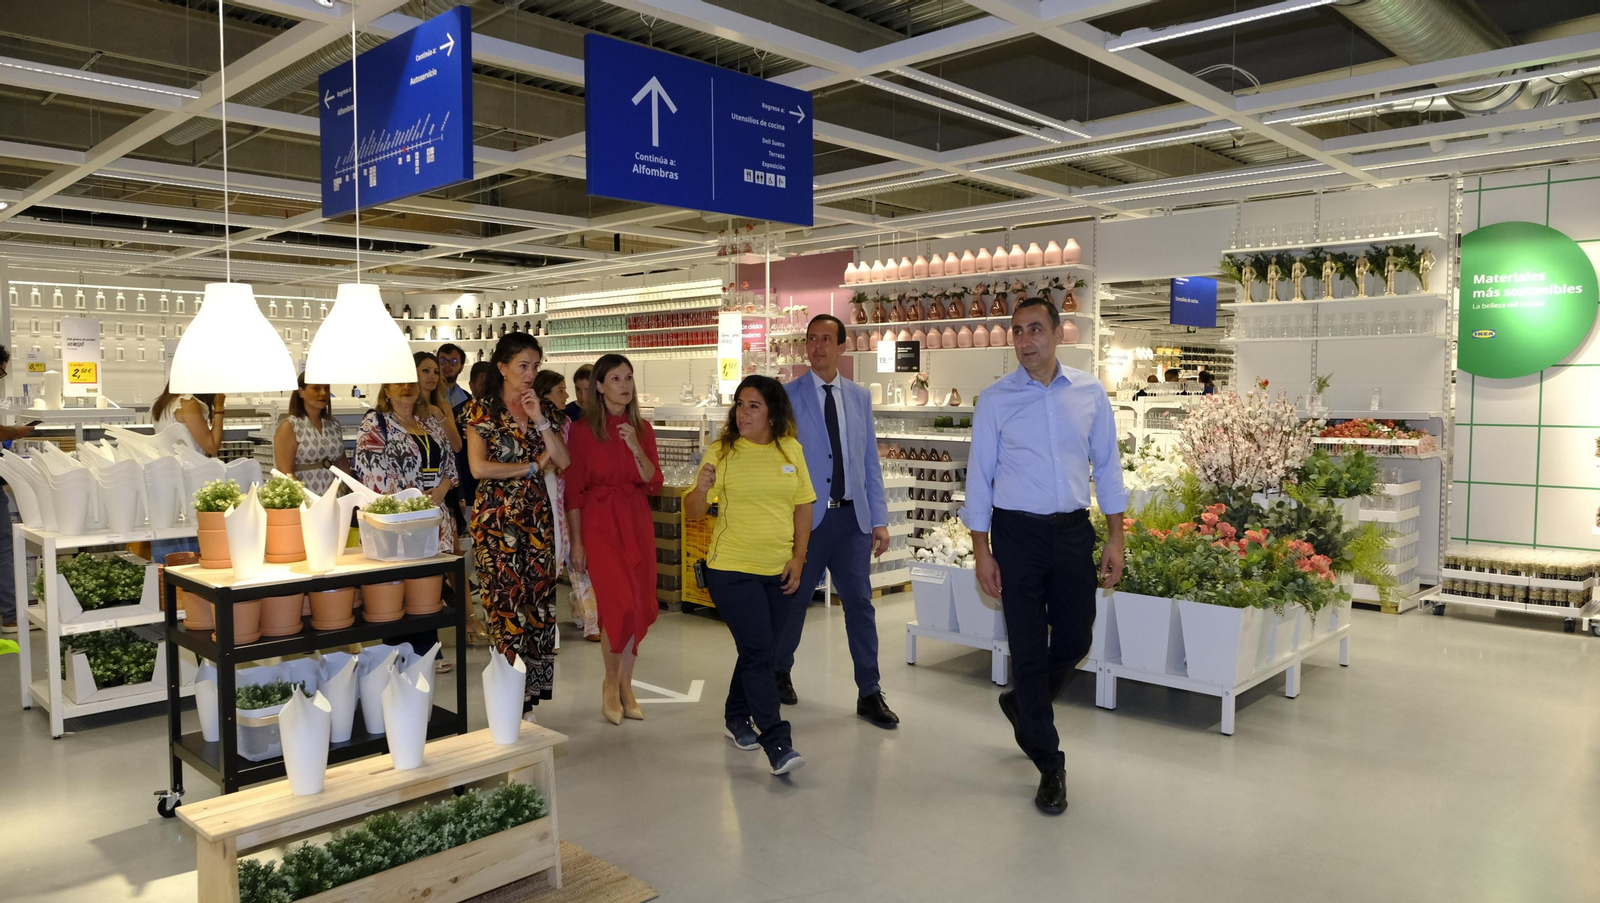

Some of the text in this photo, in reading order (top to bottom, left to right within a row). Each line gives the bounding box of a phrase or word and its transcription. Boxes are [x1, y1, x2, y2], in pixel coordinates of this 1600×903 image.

[410, 68, 438, 85] Autoservicio
[762, 102, 780, 112] Regresa
[731, 112, 759, 125] Utensilios
[768, 122, 786, 131] cocina
[634, 152, 668, 164] Continúa
[768, 150, 786, 159] Terraza
[762, 160, 786, 171] Exposición
[632, 164, 679, 180] Alfombras
[1473, 272, 1546, 284] Materiales
[1472, 284, 1583, 298] más sostenibles
